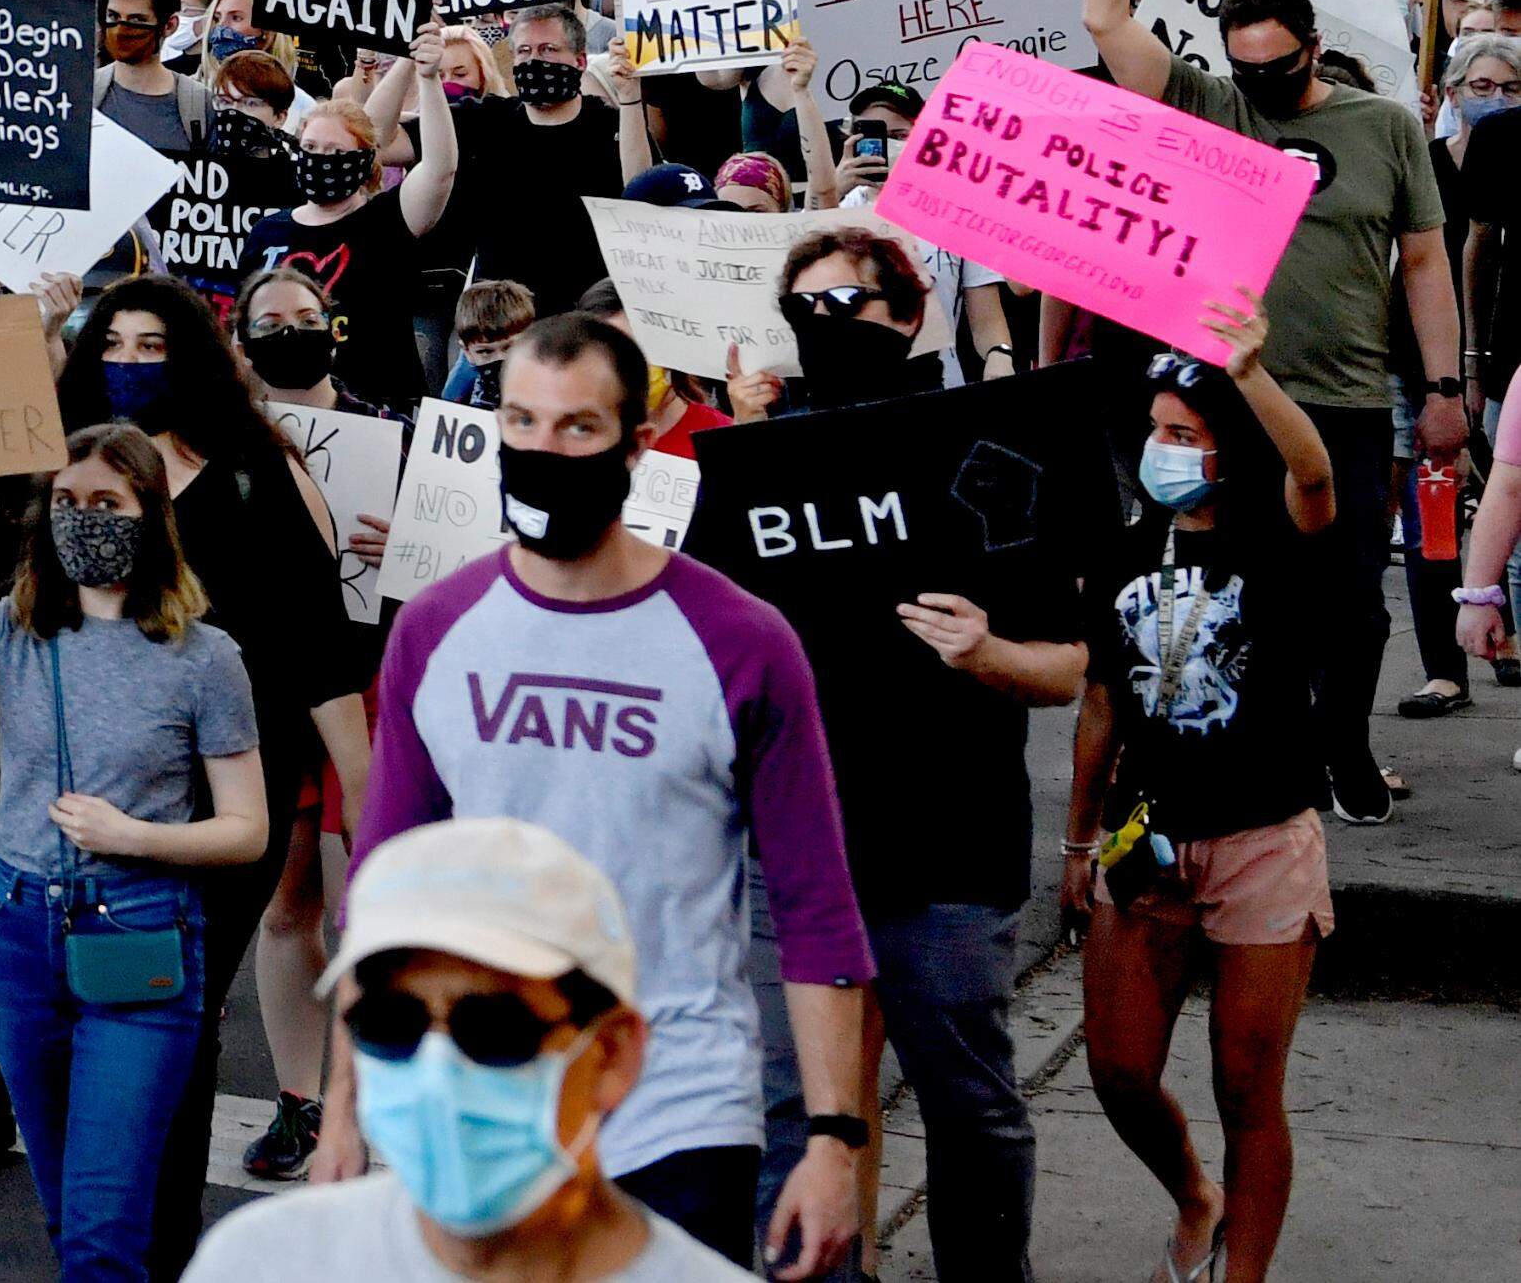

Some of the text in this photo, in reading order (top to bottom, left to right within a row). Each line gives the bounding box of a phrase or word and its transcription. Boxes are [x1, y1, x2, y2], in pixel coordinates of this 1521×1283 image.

[940, 91, 1176, 206] END POLICE
[915, 127, 1200, 279] BRUTALITY!
[432, 414, 486, 464] NO
[747, 490, 909, 560] BLM
[465, 671, 663, 760] VANS
